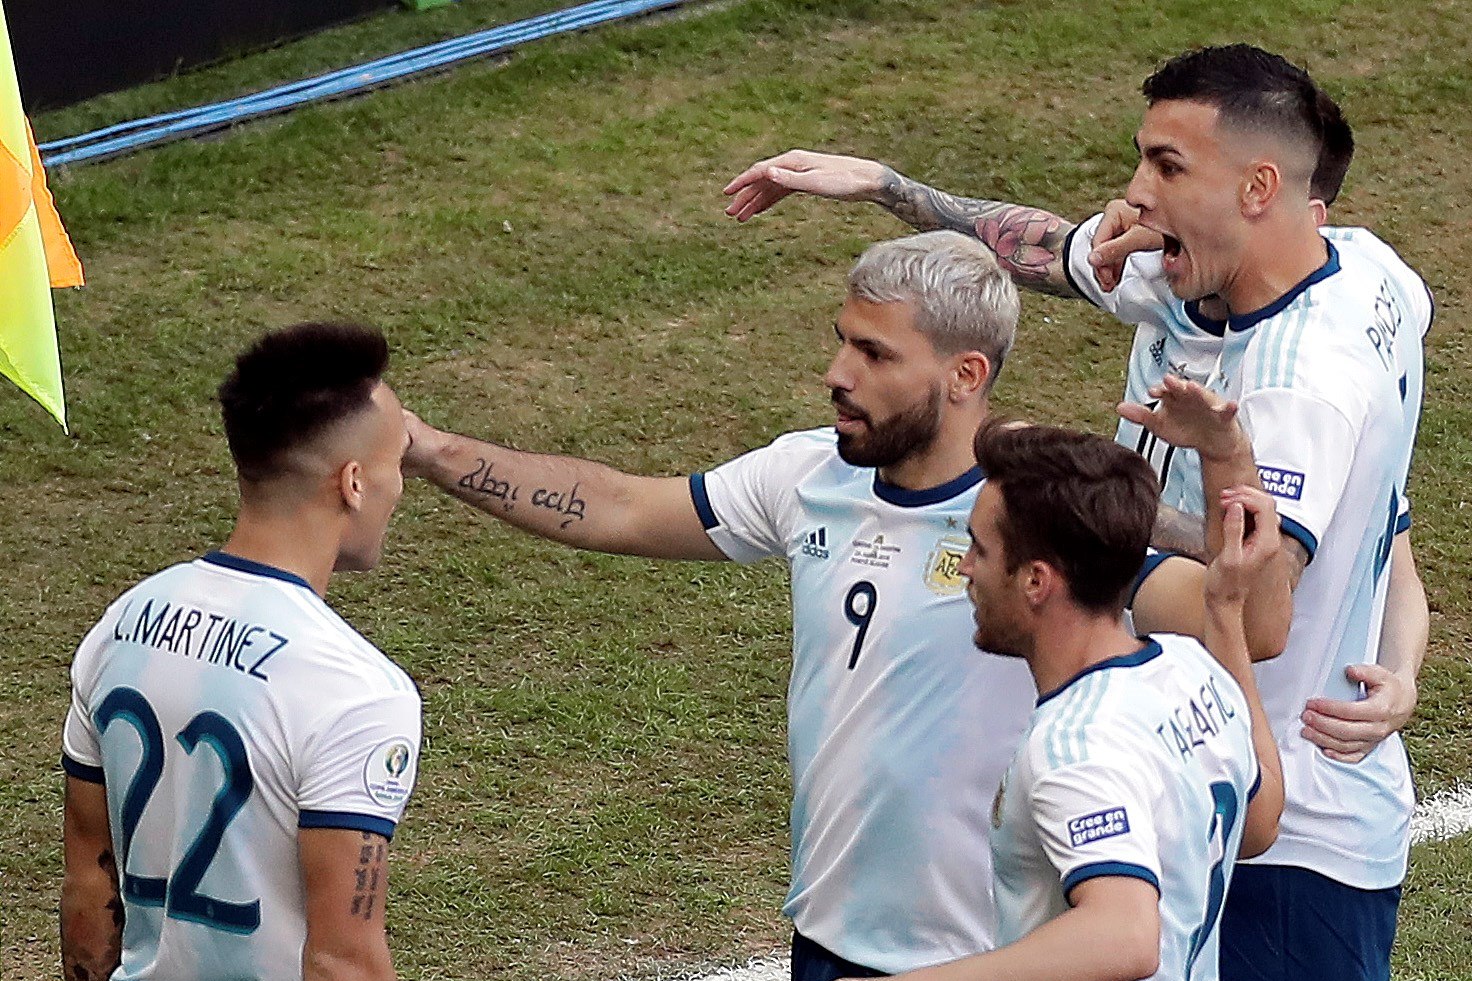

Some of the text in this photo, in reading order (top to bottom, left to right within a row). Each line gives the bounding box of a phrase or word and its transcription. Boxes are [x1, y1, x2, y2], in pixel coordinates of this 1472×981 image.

[1258, 468, 1302, 486] ree en
[114, 598, 289, 683] L.MARTINEZ
[844, 580, 878, 670] 9
[93, 686, 261, 936] 22
[1070, 810, 1125, 832] Cree en
[1073, 820, 1125, 845] grande
